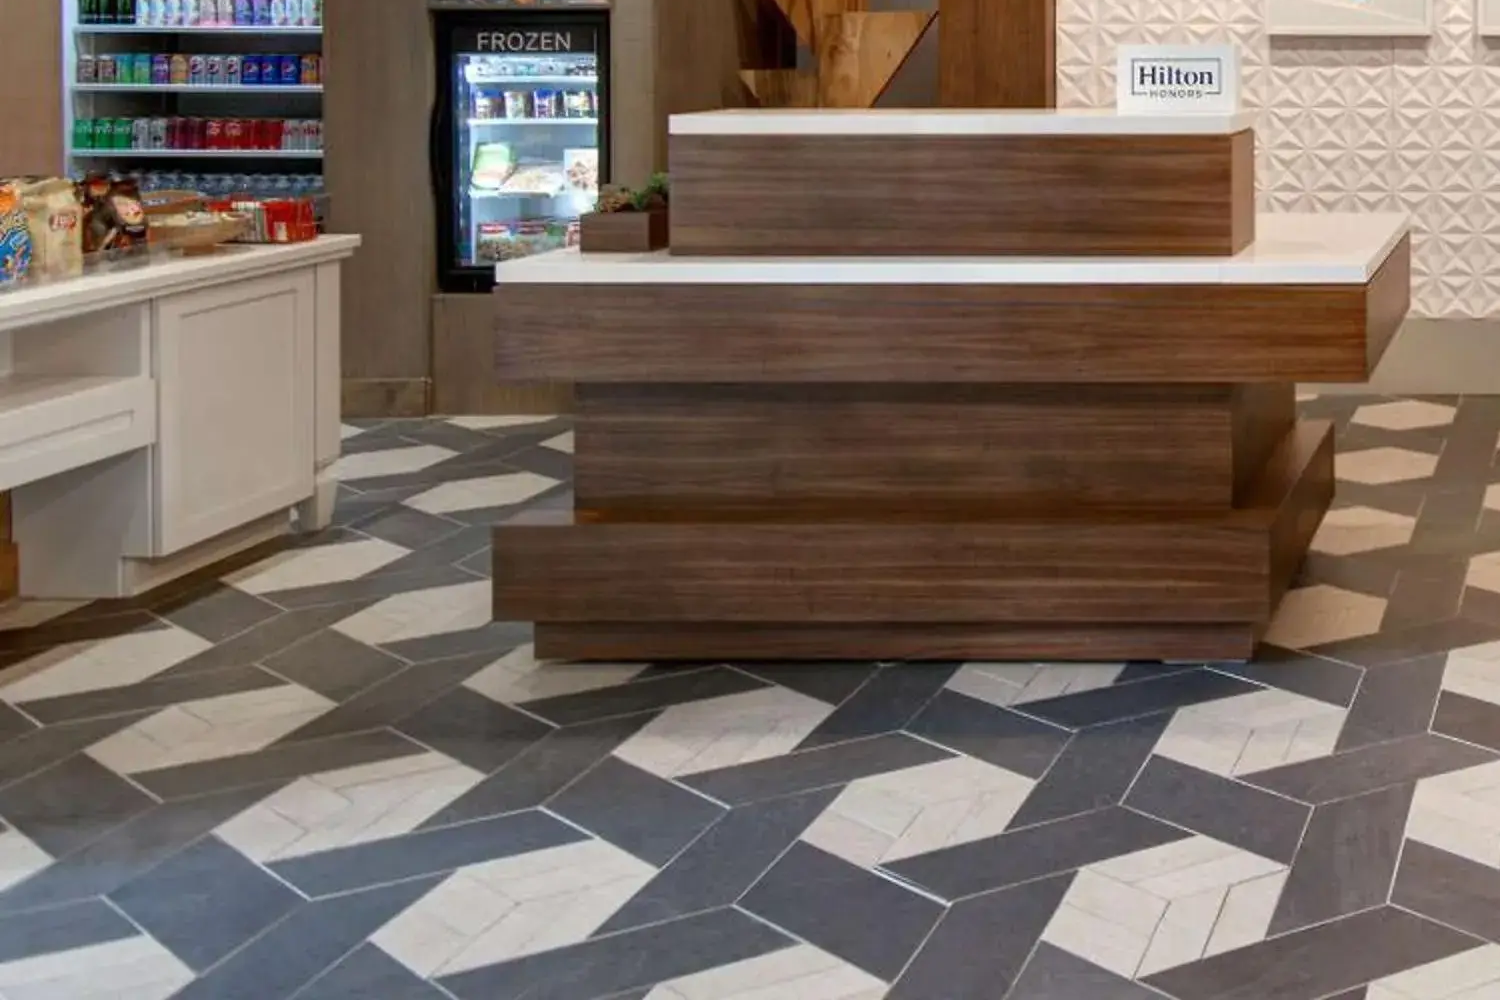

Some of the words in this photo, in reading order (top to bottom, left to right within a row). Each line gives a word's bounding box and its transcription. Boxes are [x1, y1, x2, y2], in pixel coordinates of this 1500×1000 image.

[477, 32, 571, 51] FROZEN
[1139, 66, 1213, 85] Hilton
[1149, 89, 1203, 98] HONORS
